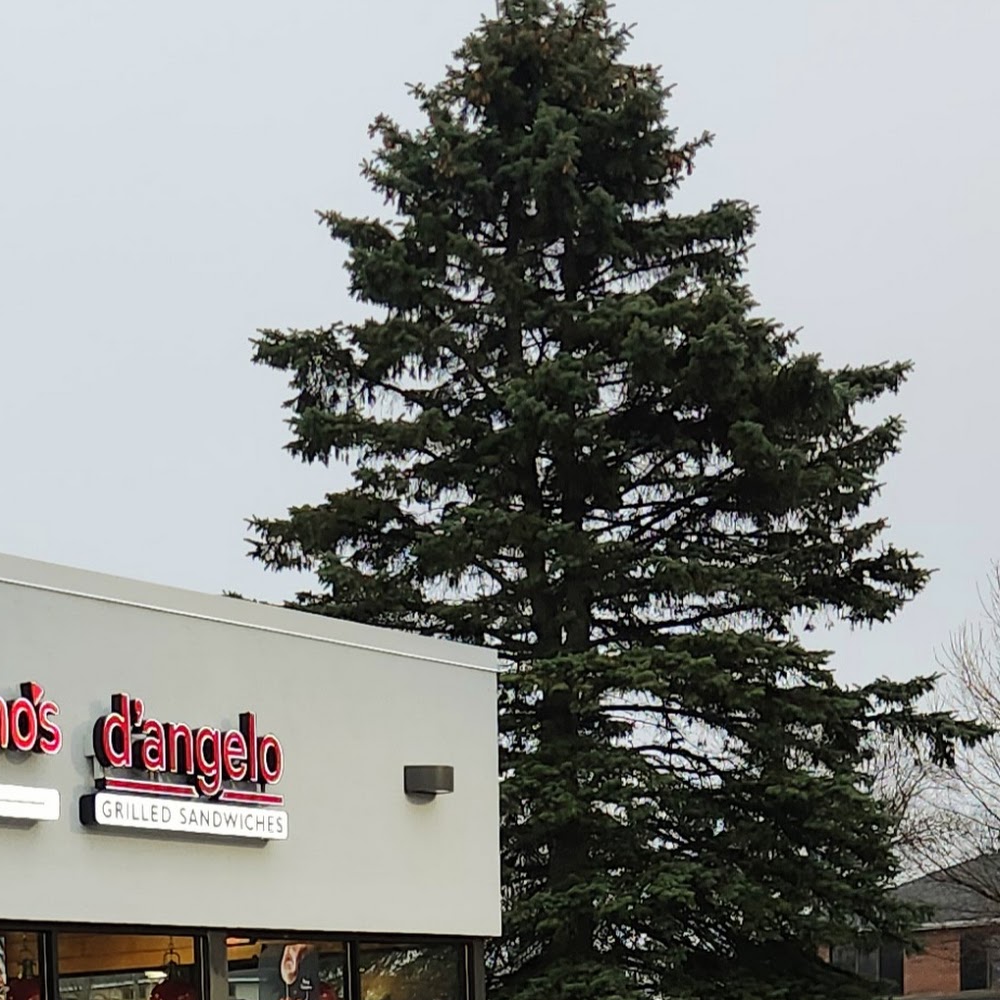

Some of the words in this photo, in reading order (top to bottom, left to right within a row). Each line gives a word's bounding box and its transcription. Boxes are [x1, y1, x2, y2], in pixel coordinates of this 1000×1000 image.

[97, 692, 284, 796] d'angelo
[101, 799, 172, 824] GRILLED
[179, 807, 284, 834] SANDWICHES
